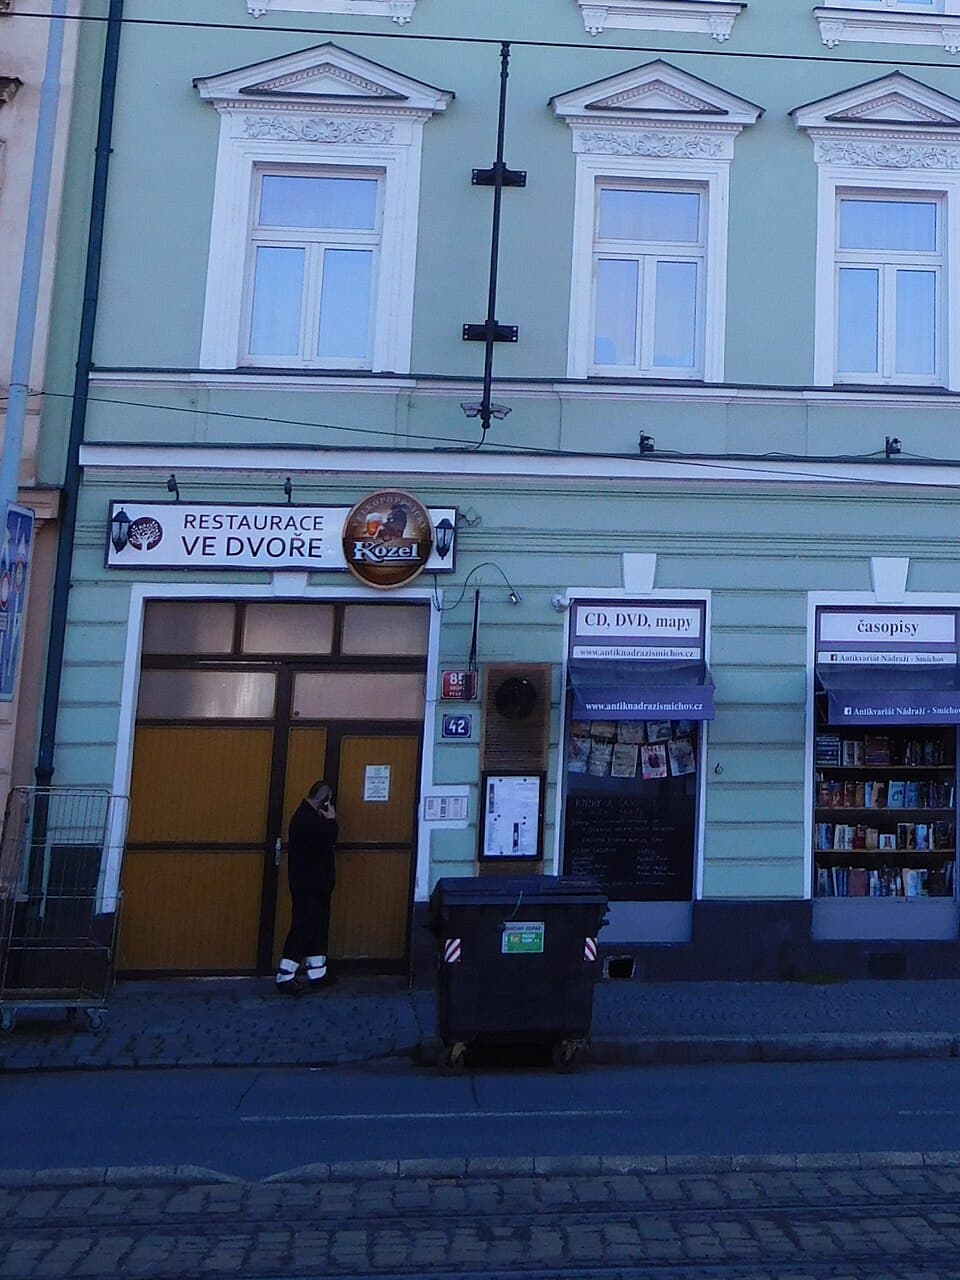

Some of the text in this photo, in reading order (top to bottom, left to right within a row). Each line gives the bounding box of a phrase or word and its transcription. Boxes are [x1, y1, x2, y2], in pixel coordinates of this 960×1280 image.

[183, 514, 324, 531] RESTAURACE
[182, 533, 323, 558] VE DVOŘE
[352, 540, 422, 563] Kozel
[584, 612, 693, 631] CD, DVD, mapy
[857, 619, 919, 637] časopisy
[585, 701, 704, 711] www.antiknadrazismichov.cz
[449, 719, 465, 733] 42
